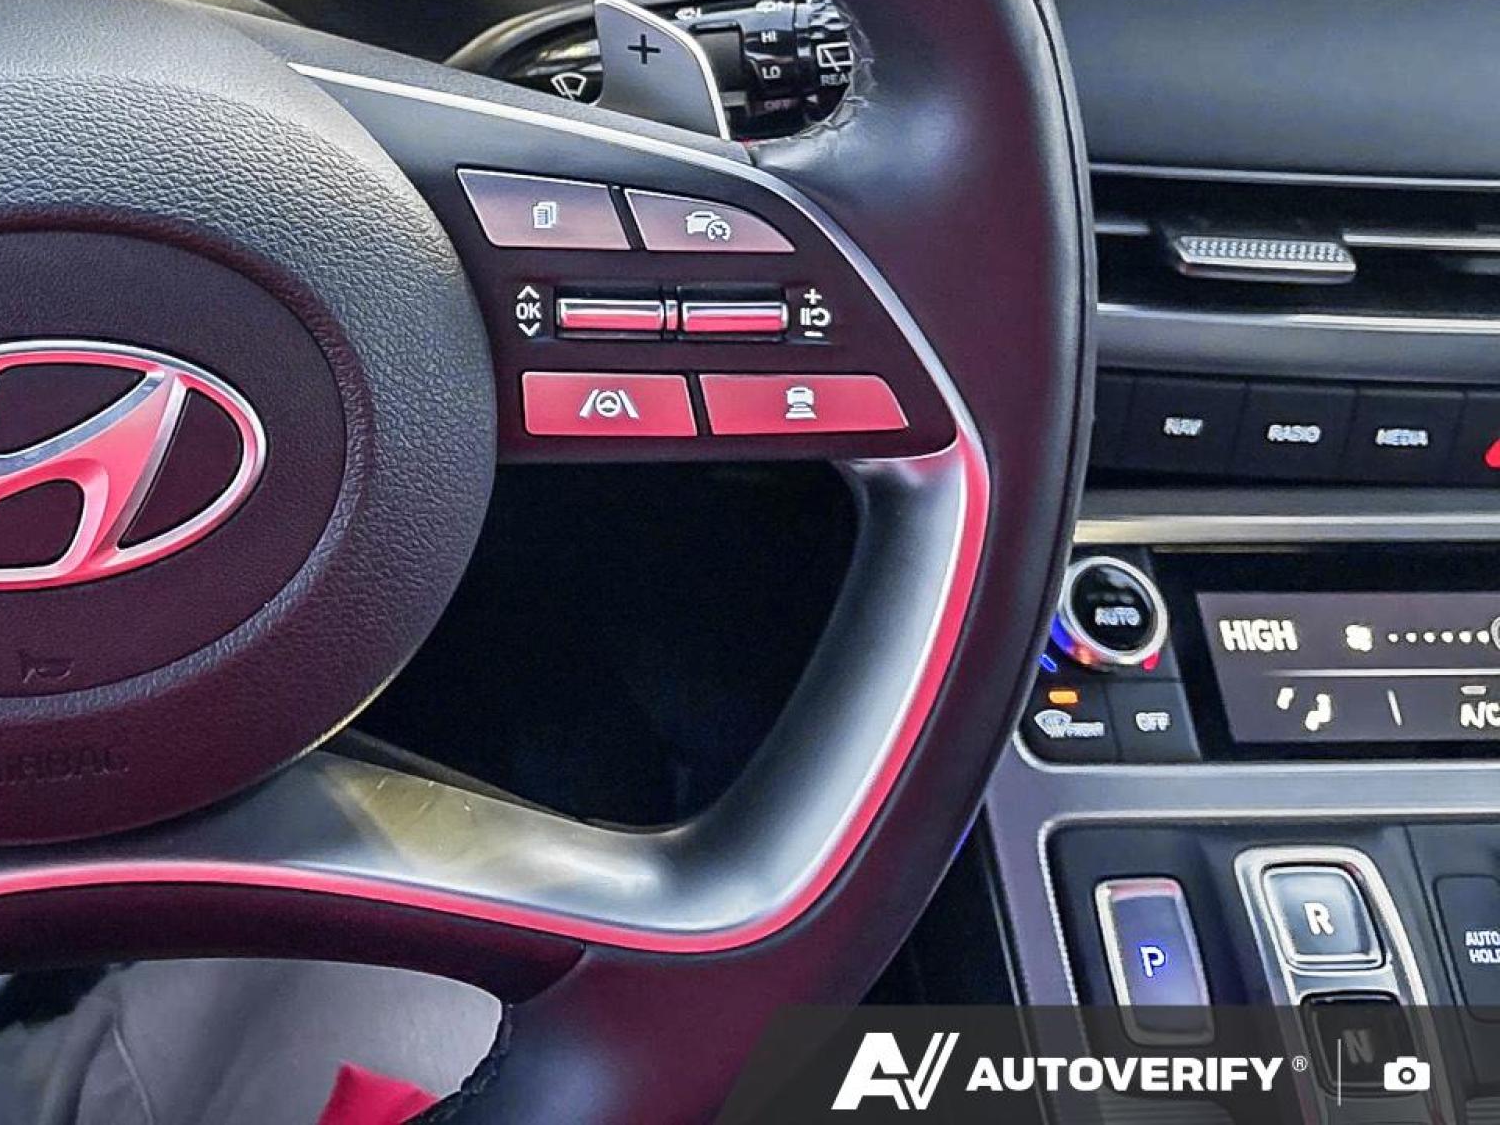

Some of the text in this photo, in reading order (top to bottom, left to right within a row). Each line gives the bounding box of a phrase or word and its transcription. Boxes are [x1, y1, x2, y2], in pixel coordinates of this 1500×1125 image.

[819, 73, 849, 86] REA
[515, 302, 542, 320] OK
[1094, 606, 1141, 626] AUTO
[1219, 618, 1299, 652] HIGH
[1135, 711, 1171, 732] OFF
[1303, 901, 1334, 936] R
[1139, 945, 1167, 979] P
